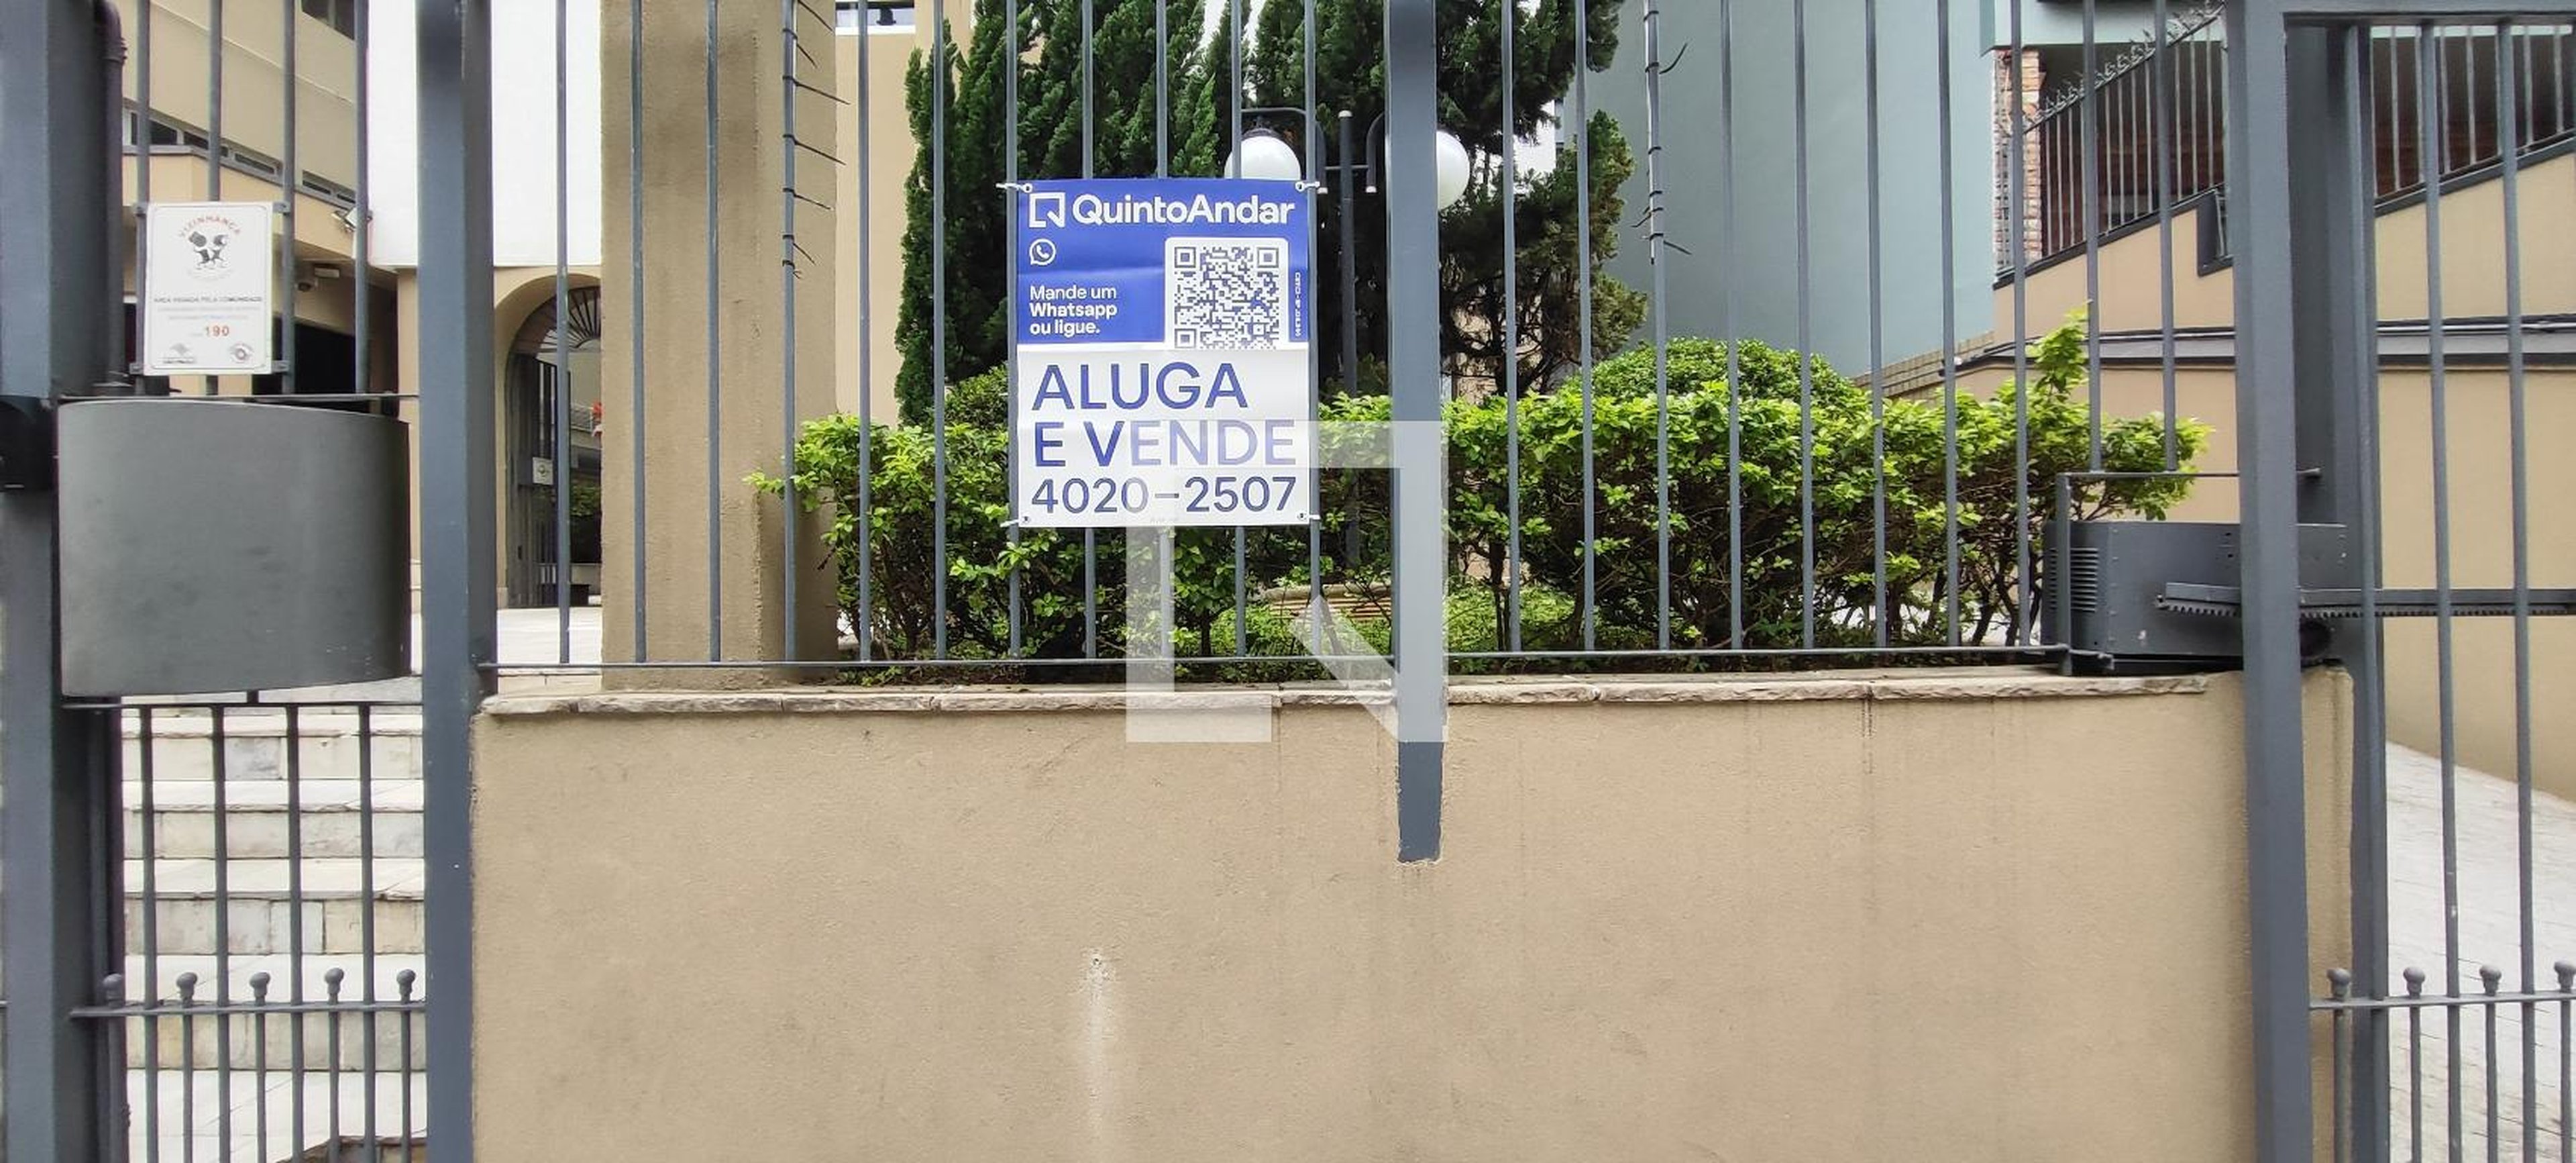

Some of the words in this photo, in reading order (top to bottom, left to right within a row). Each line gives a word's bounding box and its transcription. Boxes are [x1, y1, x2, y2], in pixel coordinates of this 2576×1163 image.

[1073, 193, 1295, 225] QuintoAndar
[1029, 285, 1087, 299] Mande
[1091, 288, 1117, 299] um
[1029, 302, 1118, 319] Whatsapp
[205, 325, 230, 337] 190
[1029, 322, 1051, 334] ou
[1054, 318, 1100, 338] ligue.
[1031, 361, 1248, 411] ALUGA
[1034, 421, 1066, 467] E
[1083, 419, 1296, 467] VENDE
[1031, 476, 1296, 514] 4020-2507
